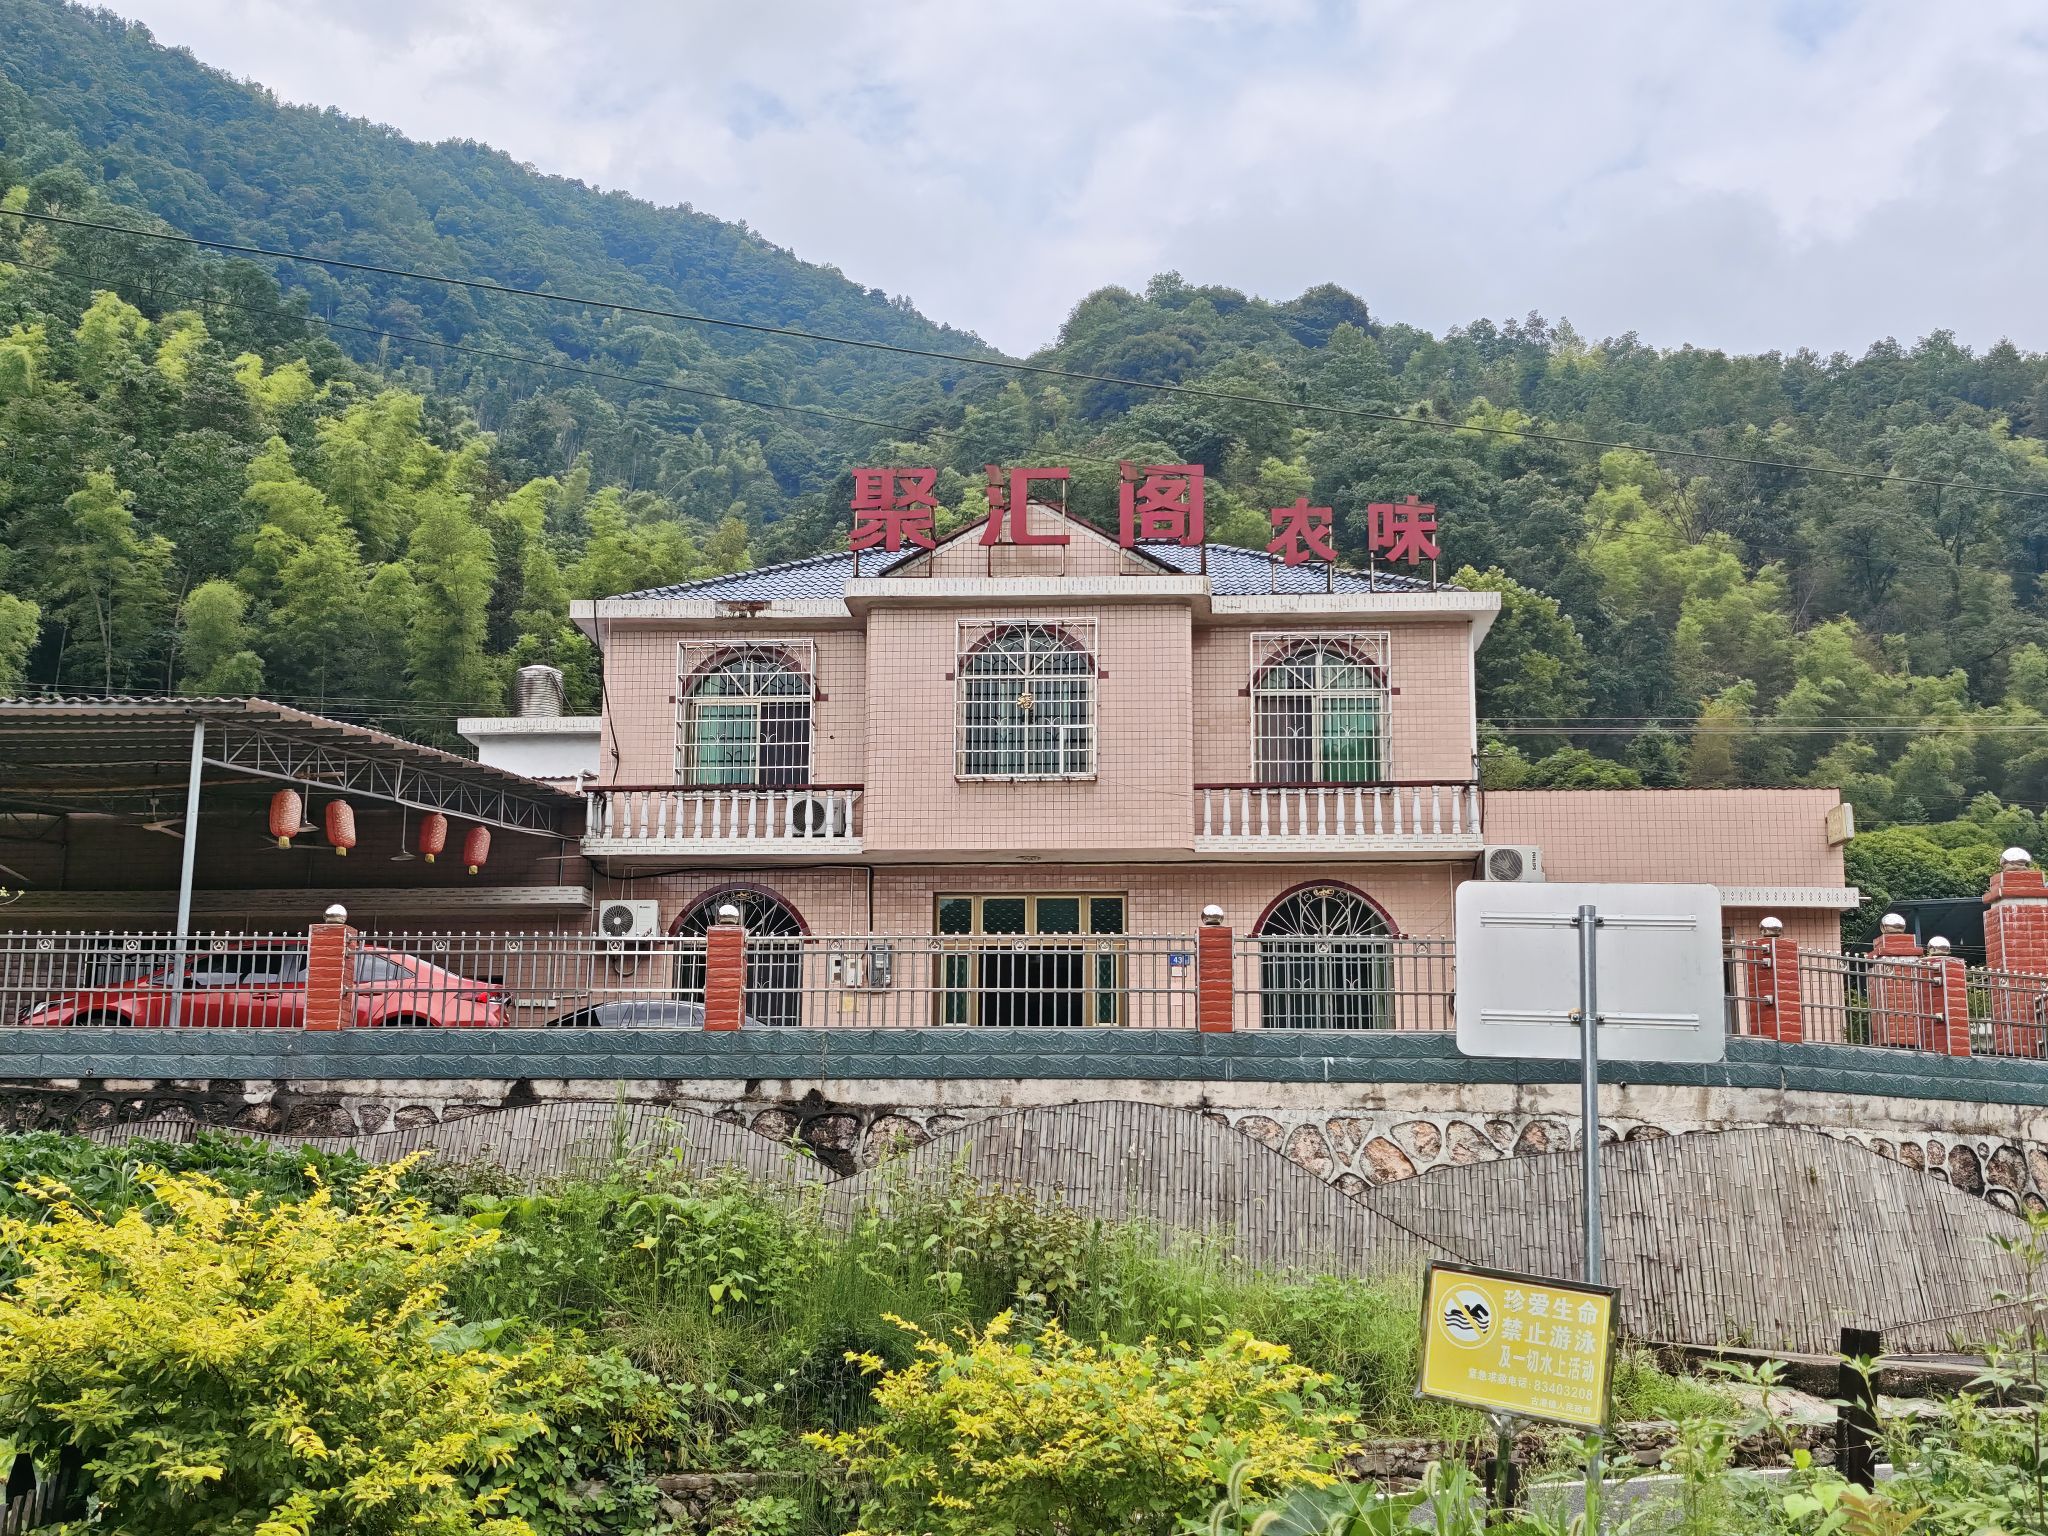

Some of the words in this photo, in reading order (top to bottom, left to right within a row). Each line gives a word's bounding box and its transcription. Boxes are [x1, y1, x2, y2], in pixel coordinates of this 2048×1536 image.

[850, 461, 1205, 550] 聚汇阁
[1266, 495, 1440, 567] 农味
[1503, 1289, 1598, 1326] 珍爱生命
[1500, 1317, 1596, 1354] 禁止游泳
[1498, 1344, 1595, 1382] 及一切水上活动
